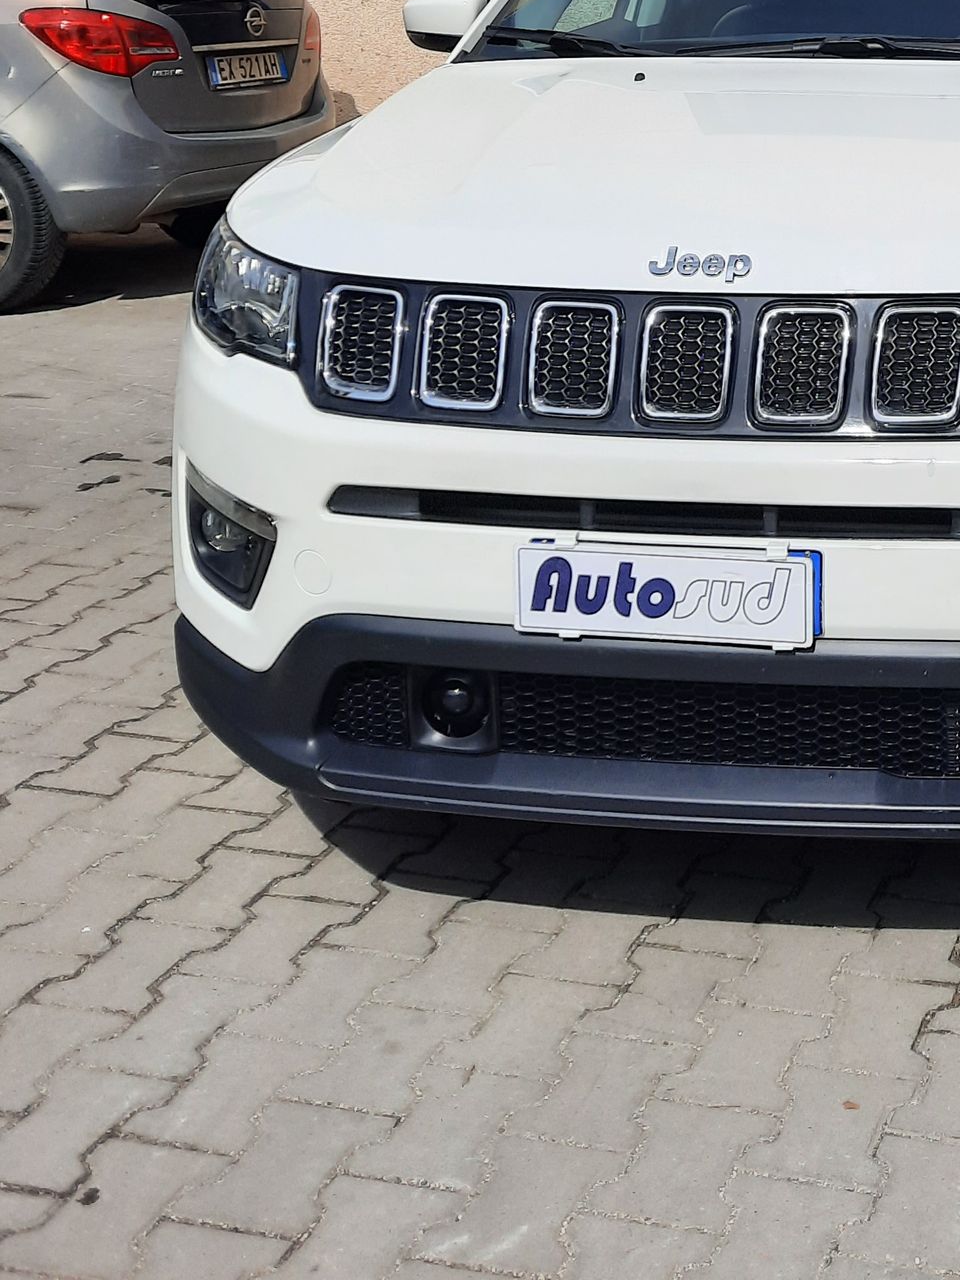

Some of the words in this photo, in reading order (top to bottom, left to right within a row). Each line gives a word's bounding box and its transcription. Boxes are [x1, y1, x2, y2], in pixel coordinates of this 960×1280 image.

[216, 57, 236, 81] EX
[238, 54, 279, 79] 521AH
[648, 246, 752, 283] Jeep
[530, 556, 792, 625] Autosud
